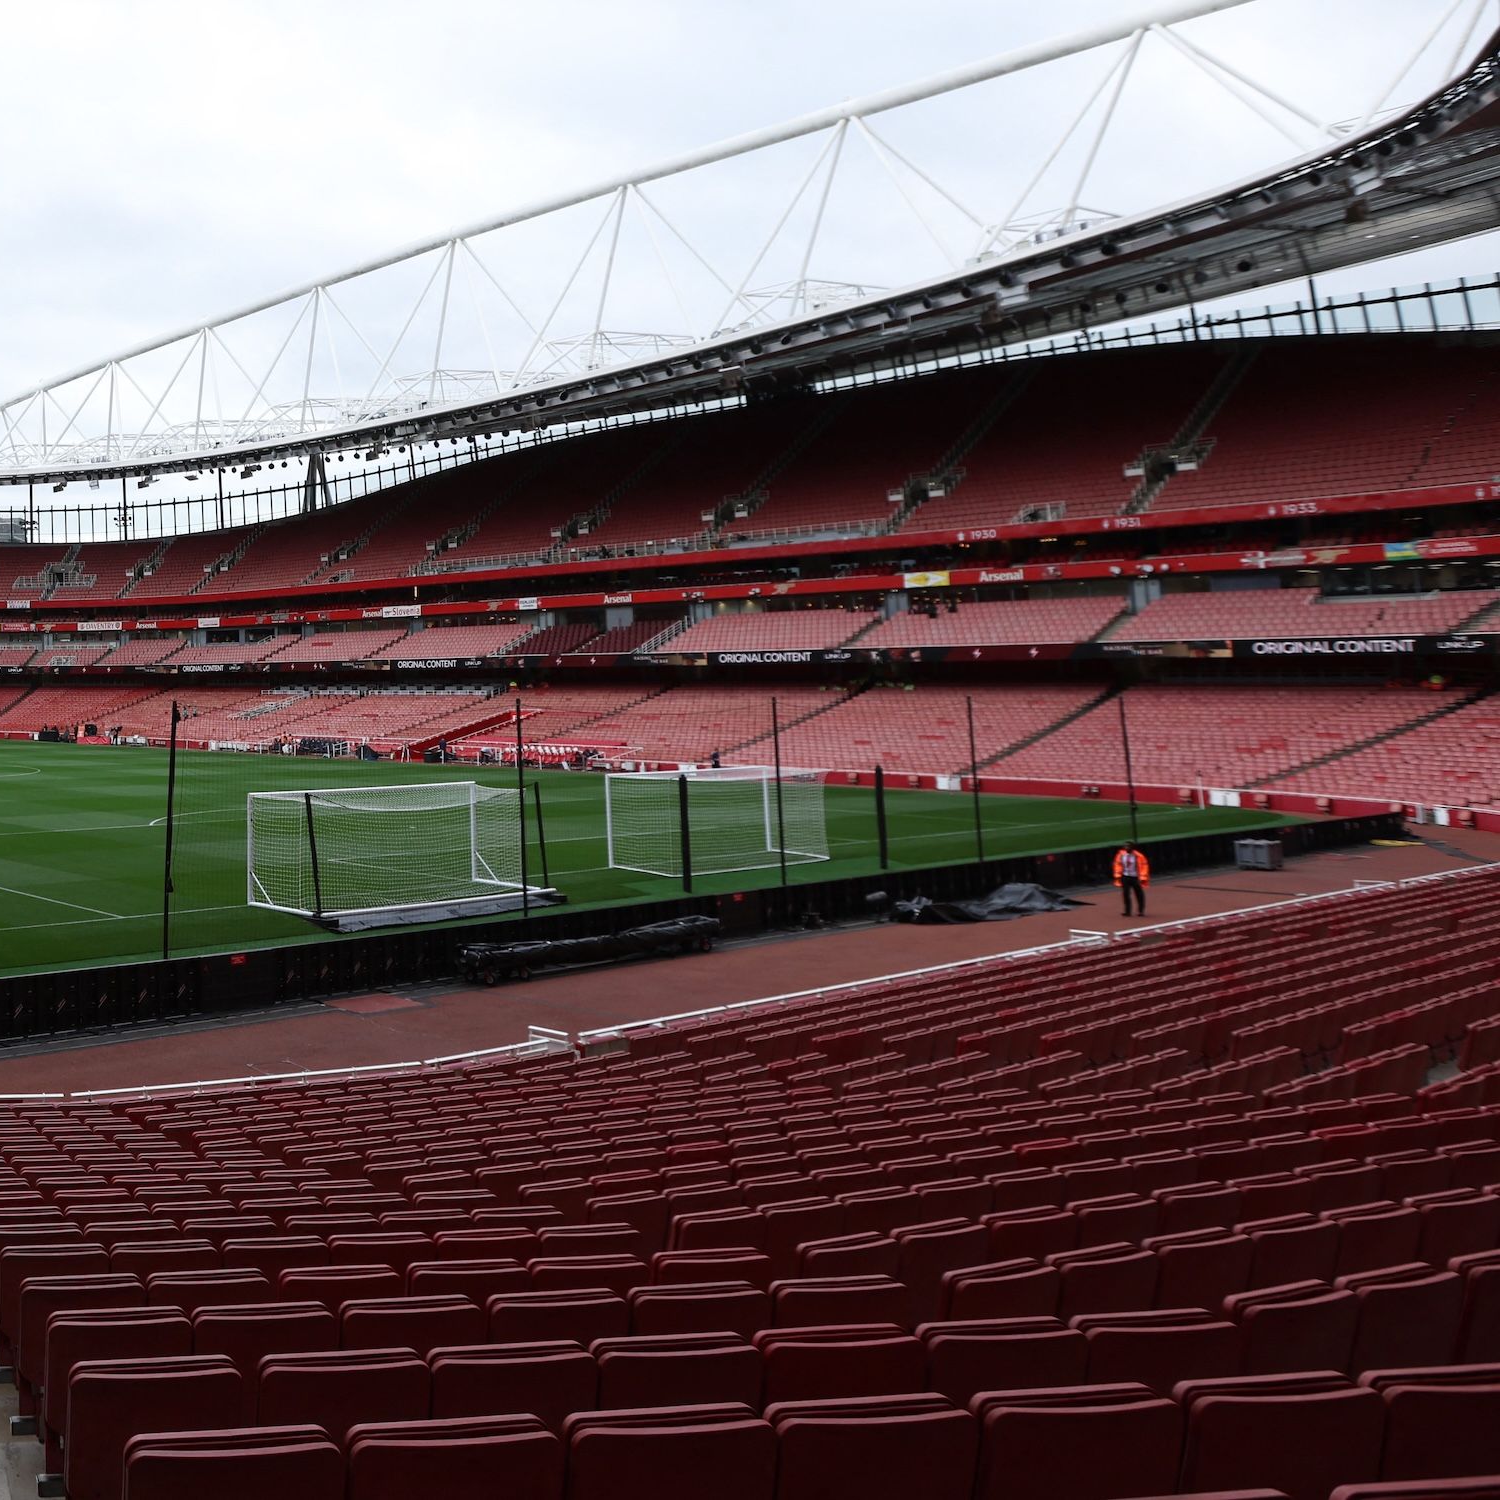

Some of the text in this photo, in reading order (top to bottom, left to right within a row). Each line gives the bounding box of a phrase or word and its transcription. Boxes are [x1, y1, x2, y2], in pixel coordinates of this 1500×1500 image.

[1282, 503, 1316, 514] 1933
[1114, 518, 1140, 528] 1931
[970, 529, 996, 540] 1930
[979, 569, 1024, 582] Arsenal
[604, 594, 632, 604] Arsenal
[362, 609, 382, 618] Arsenal
[392, 605, 420, 616] Slovenia
[86, 622, 115, 631] DAVENTRY
[1252, 640, 1416, 655] ORIGINAL CONTENT
[719, 652, 812, 664] ORIGINAL CONTENT
[398, 660, 456, 669] ORIGINAL CONTENT
